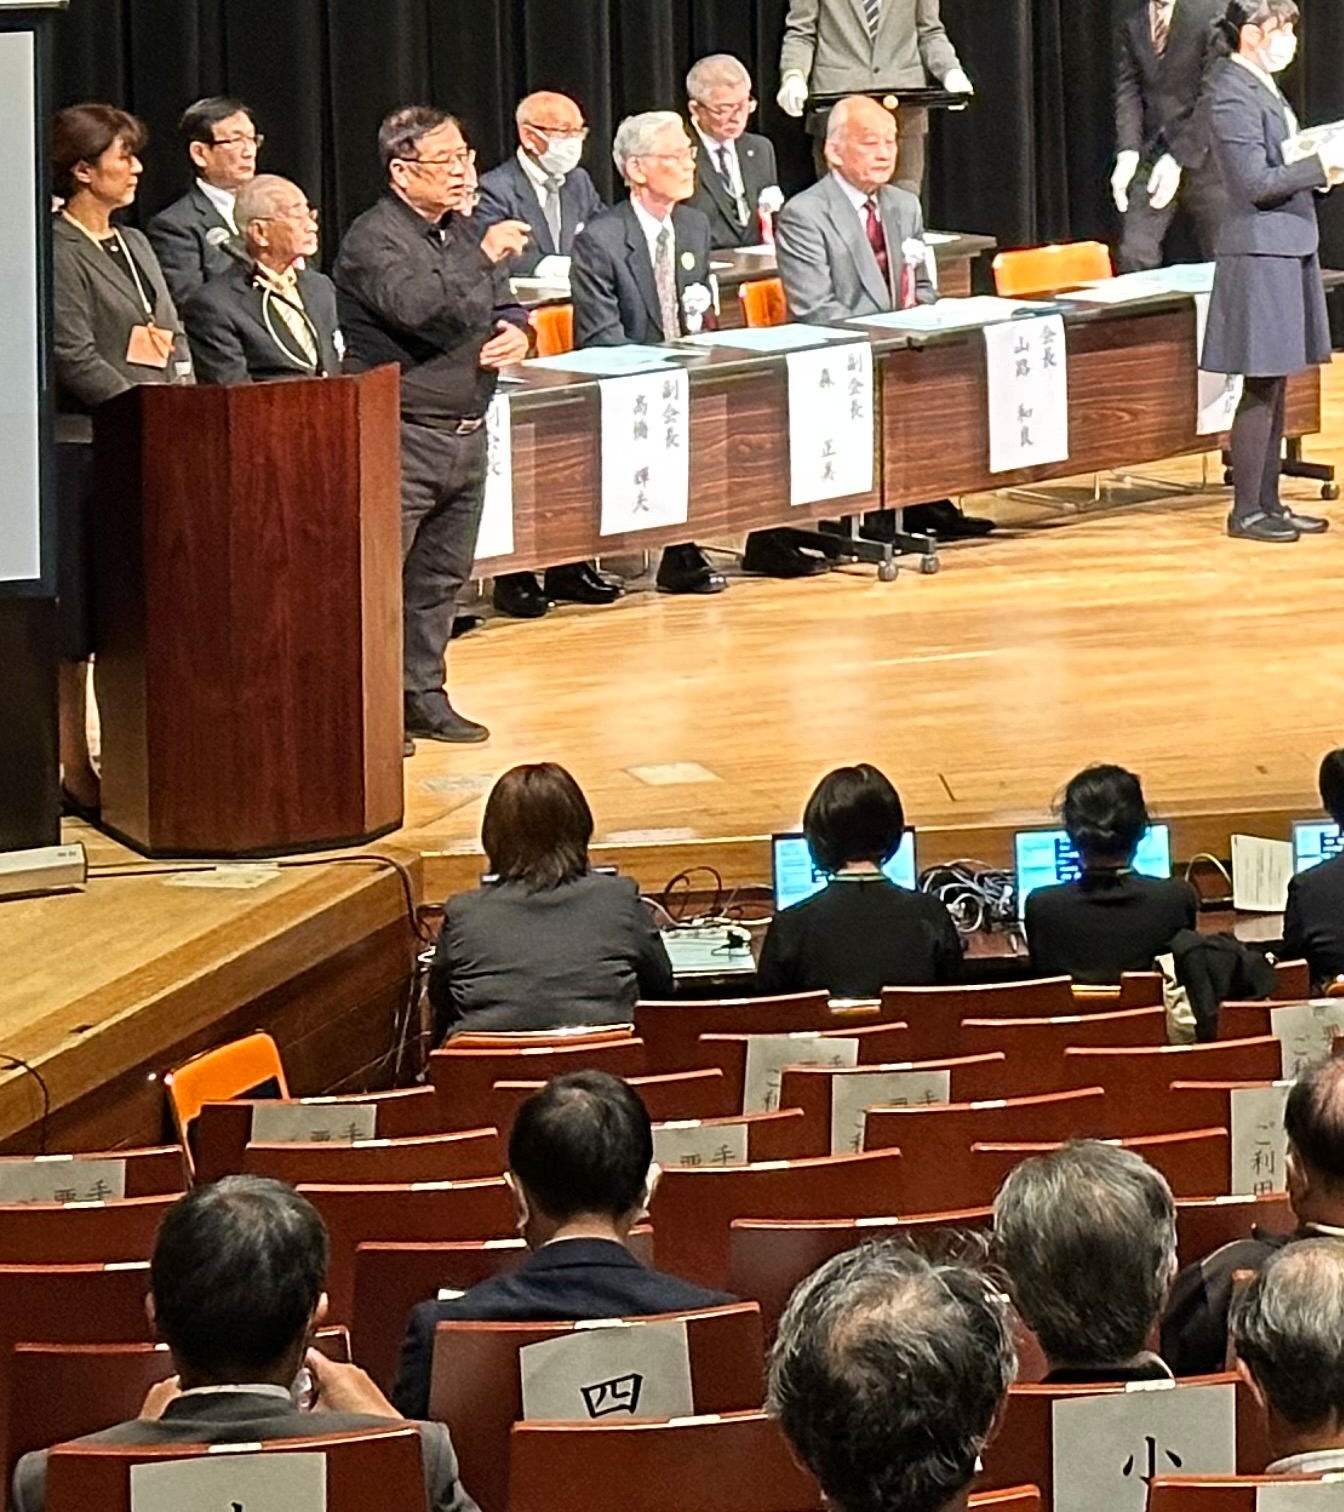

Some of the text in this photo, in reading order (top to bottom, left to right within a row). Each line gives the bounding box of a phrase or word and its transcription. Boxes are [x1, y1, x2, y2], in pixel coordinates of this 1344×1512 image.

[1040, 325, 1057, 368] 会長
[662, 380, 679, 448] 副会長
[580, 1374, 643, 1418] 四
